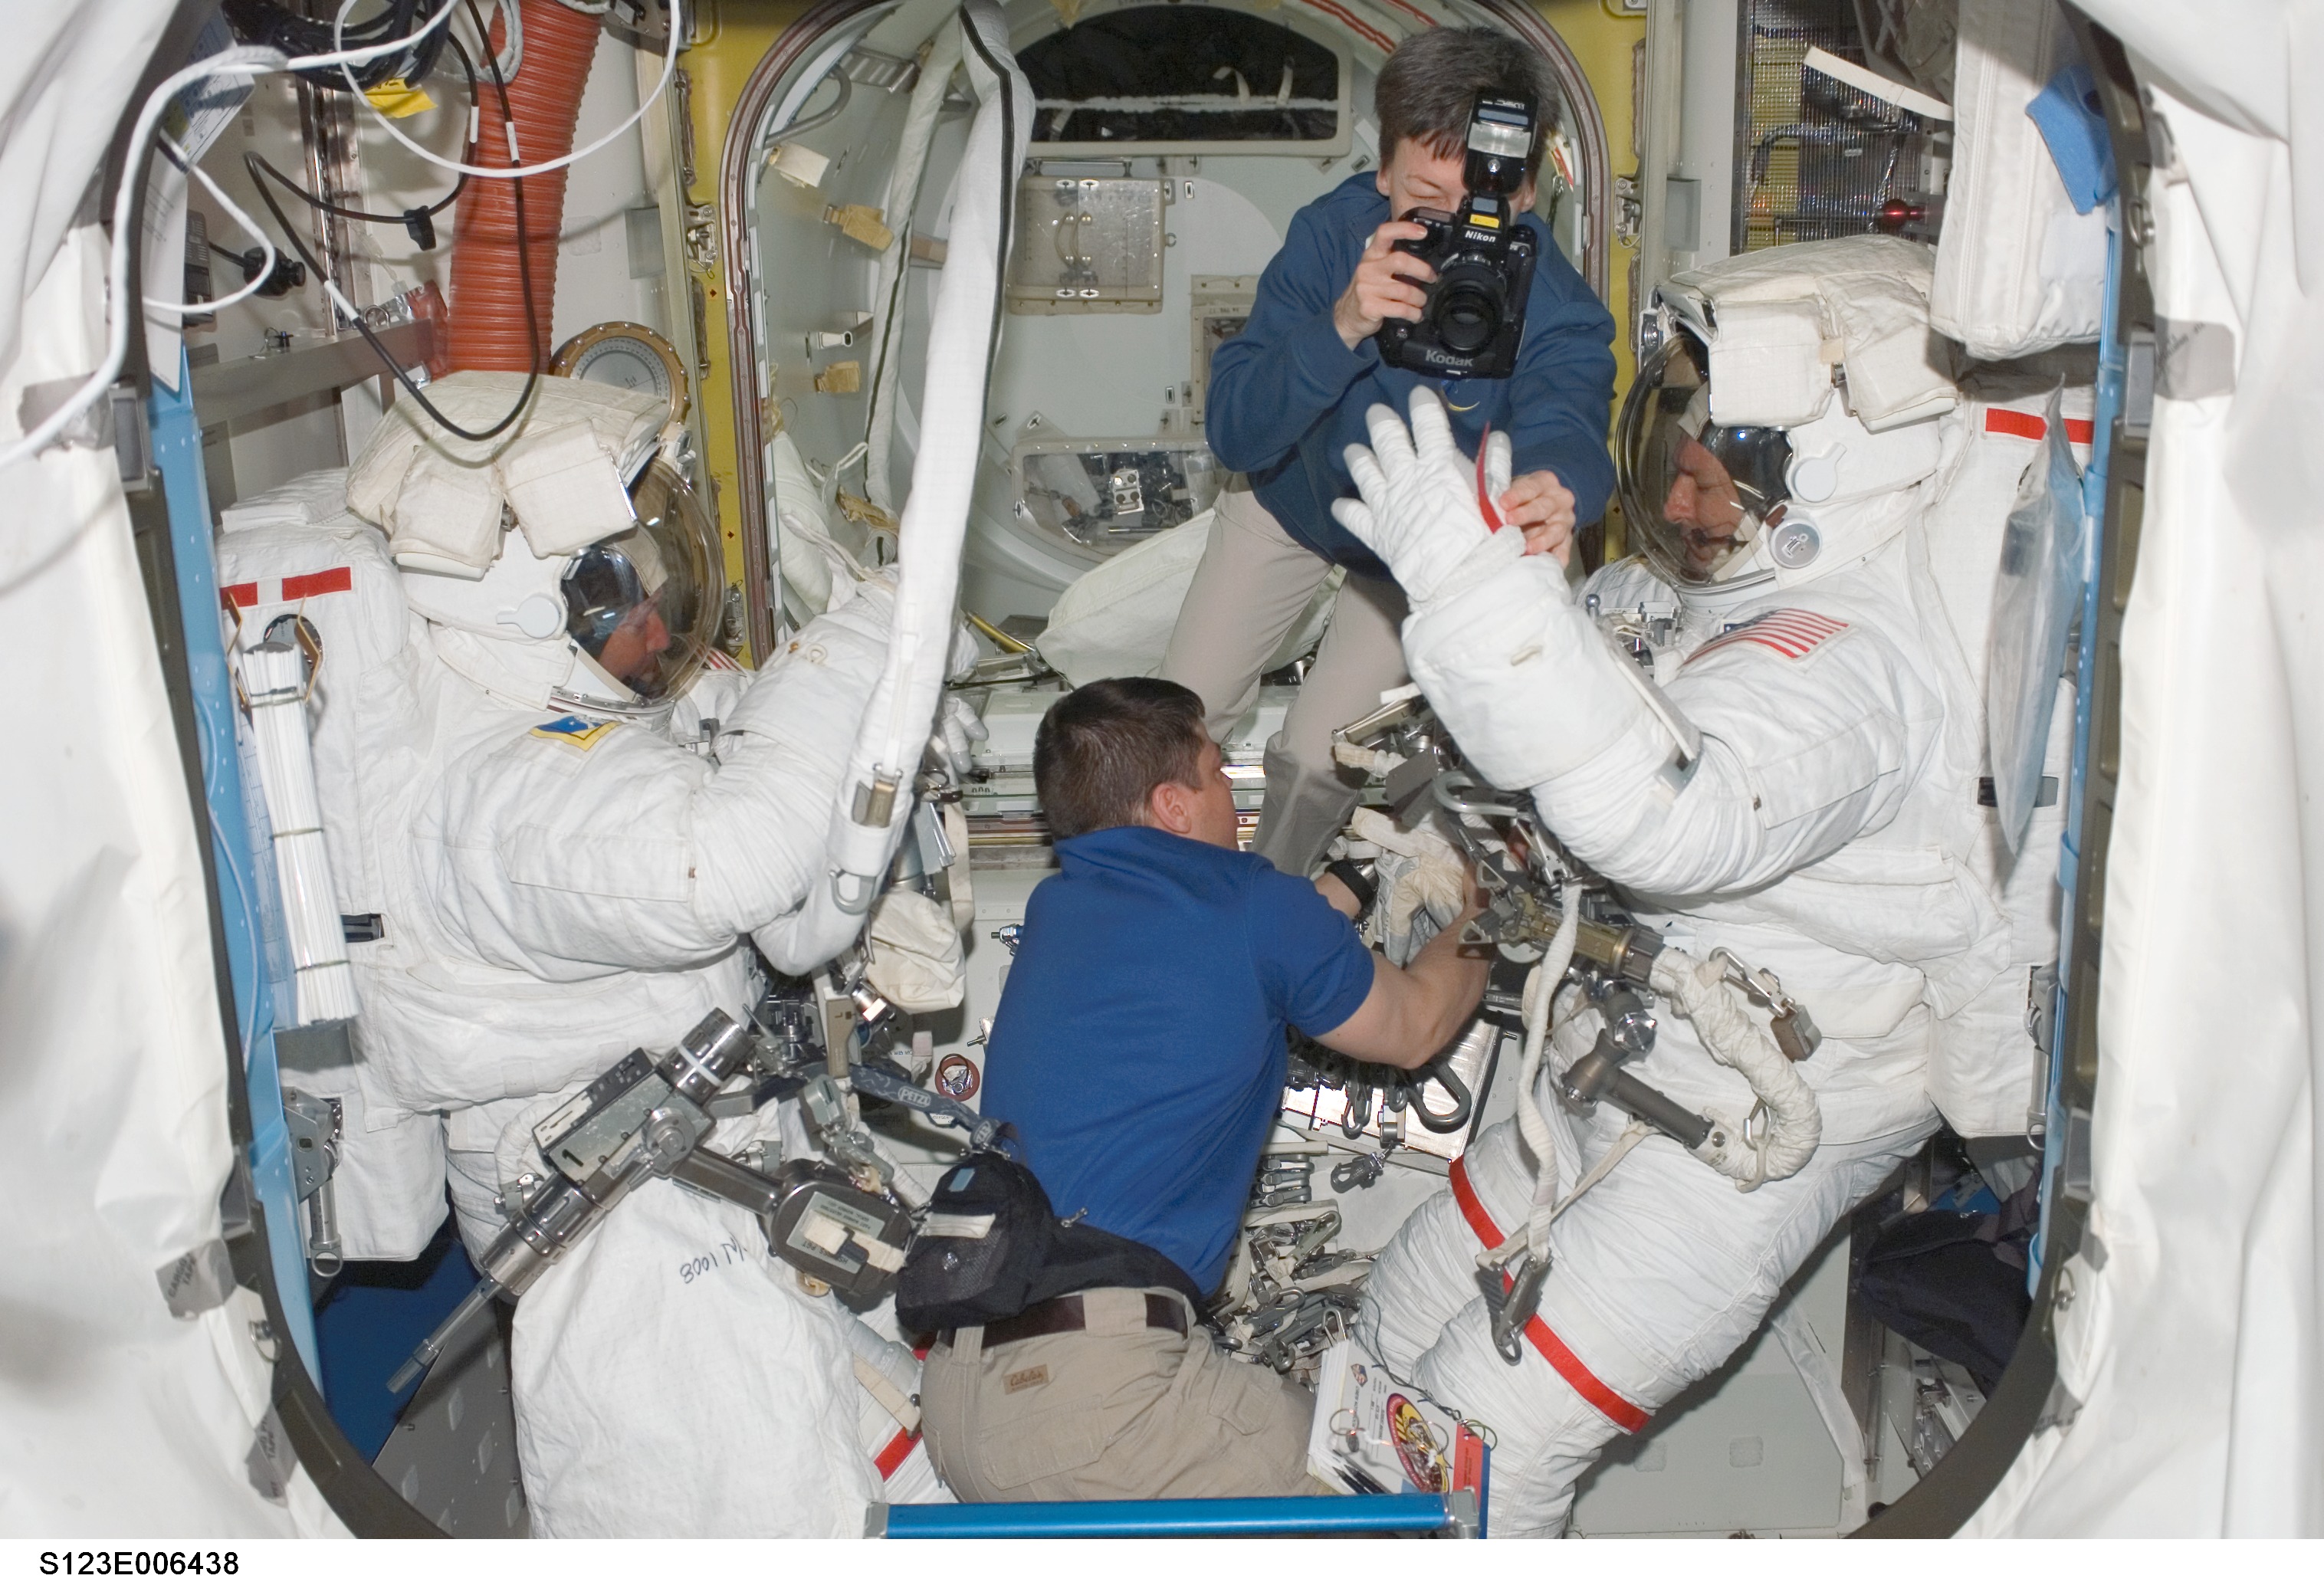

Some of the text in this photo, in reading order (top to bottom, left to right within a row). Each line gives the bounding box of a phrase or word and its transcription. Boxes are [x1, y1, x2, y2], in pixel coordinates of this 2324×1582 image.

[1465, 230, 1496, 243] Nikon
[1425, 349, 1473, 367] Kodak
[899, 1088, 931, 1107] PETZL
[562, 1149, 584, 1167] 1
